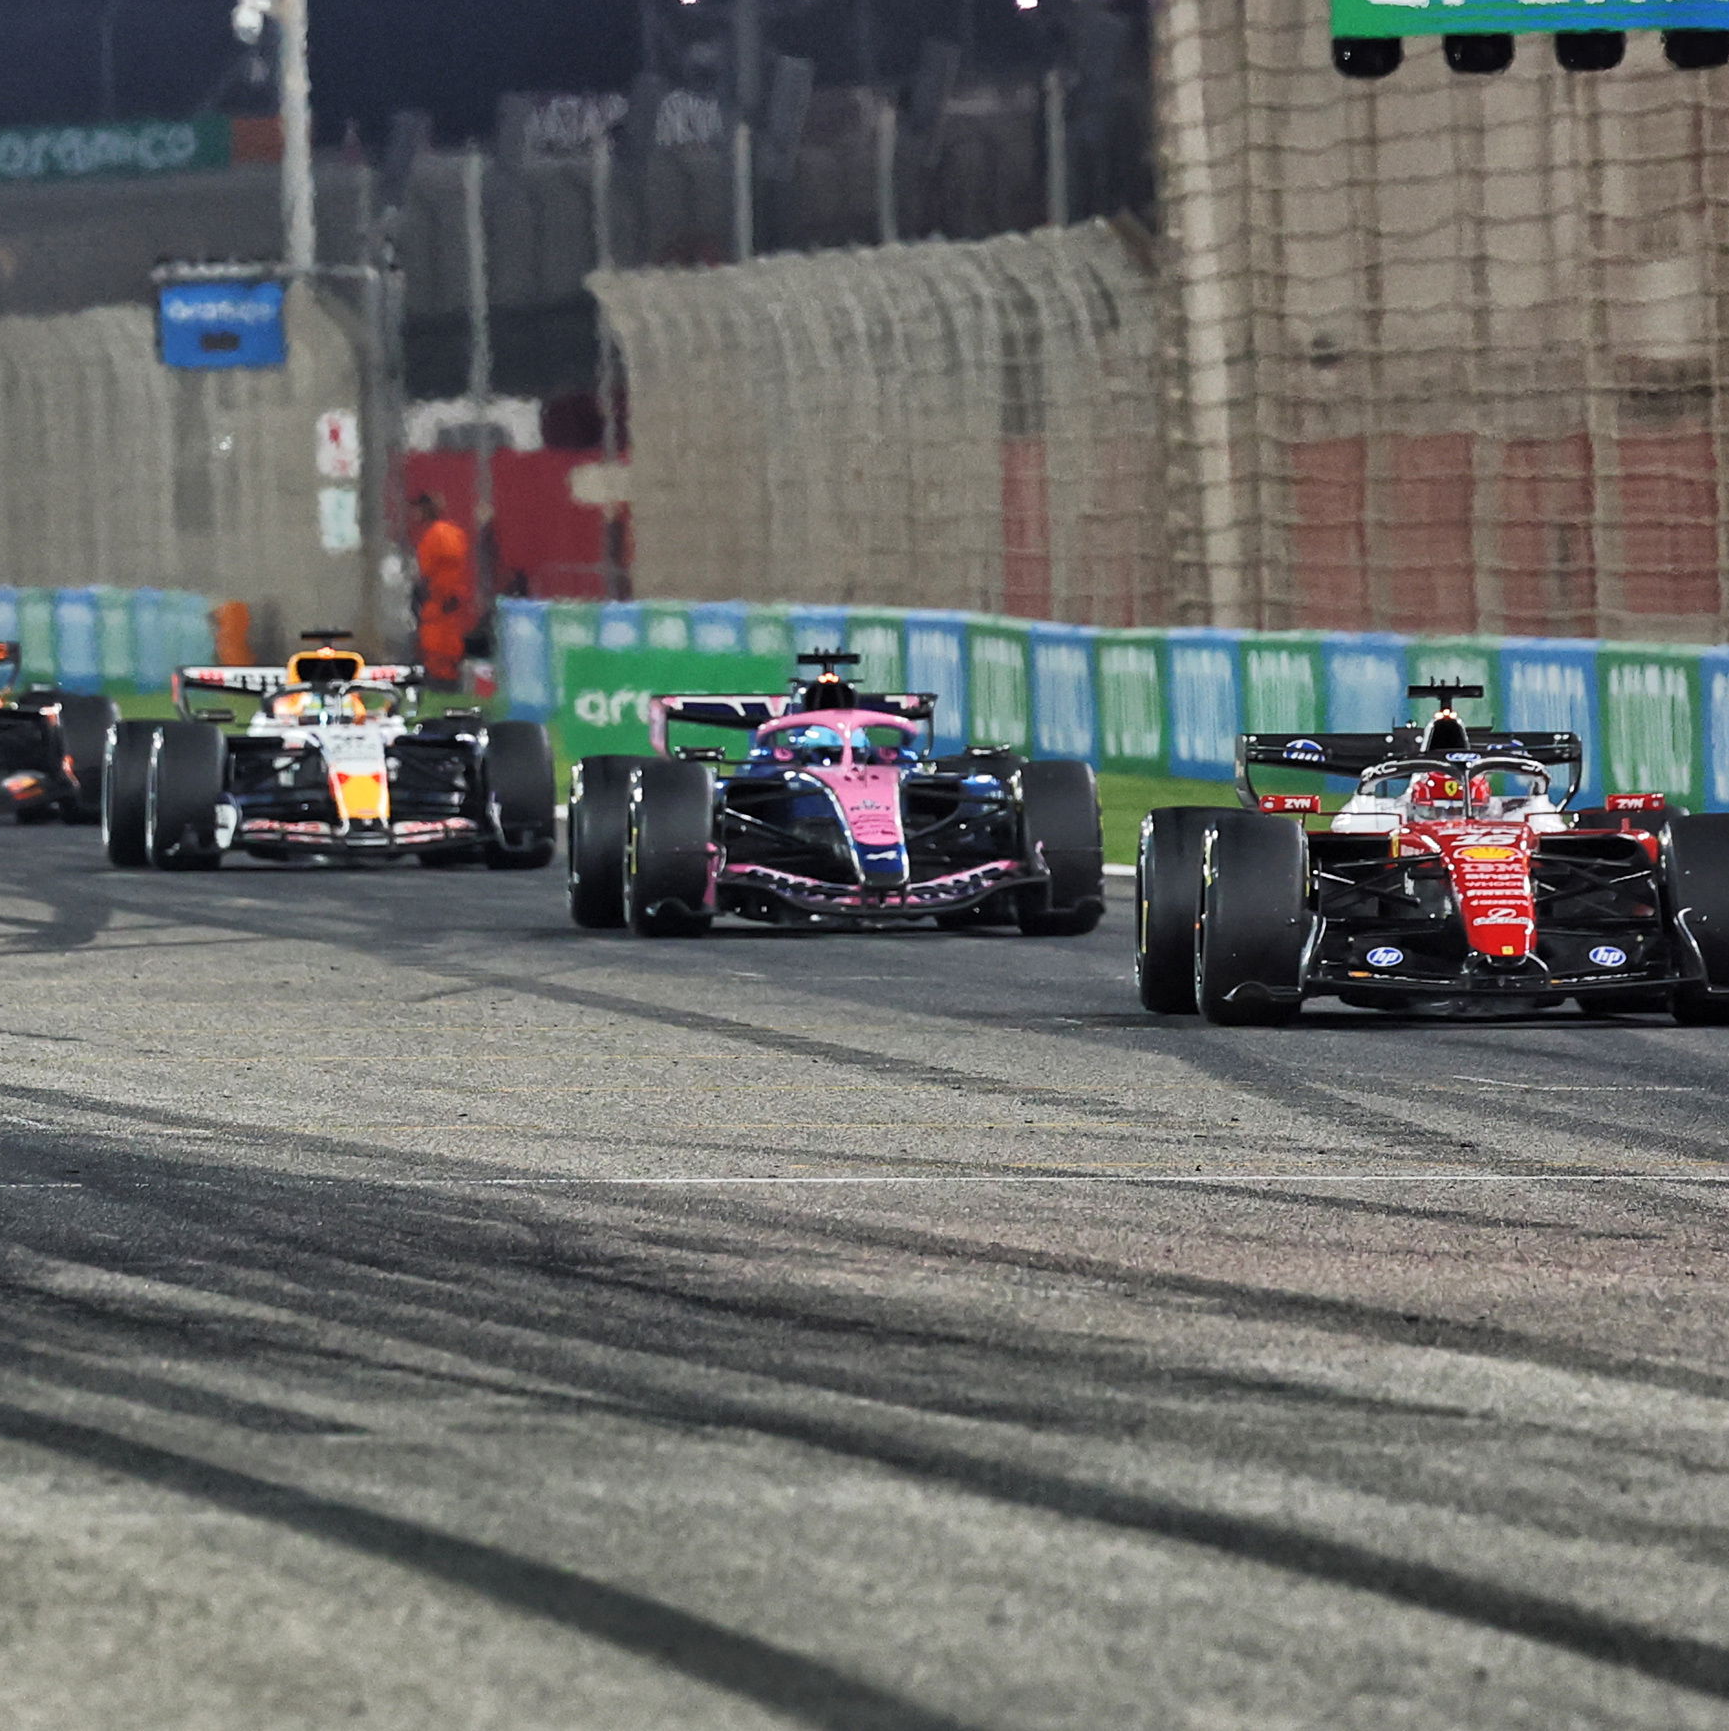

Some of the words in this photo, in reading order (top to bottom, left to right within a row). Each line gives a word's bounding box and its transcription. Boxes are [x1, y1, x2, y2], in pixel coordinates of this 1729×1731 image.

[1284, 798, 1312, 810] ZYN
[1615, 798, 1645, 810] ZYN
[1450, 834, 1517, 846] 16
[1460, 863, 1524, 873] IBM
[1372, 949, 1398, 967] hp
[1595, 948, 1621, 967] hp
